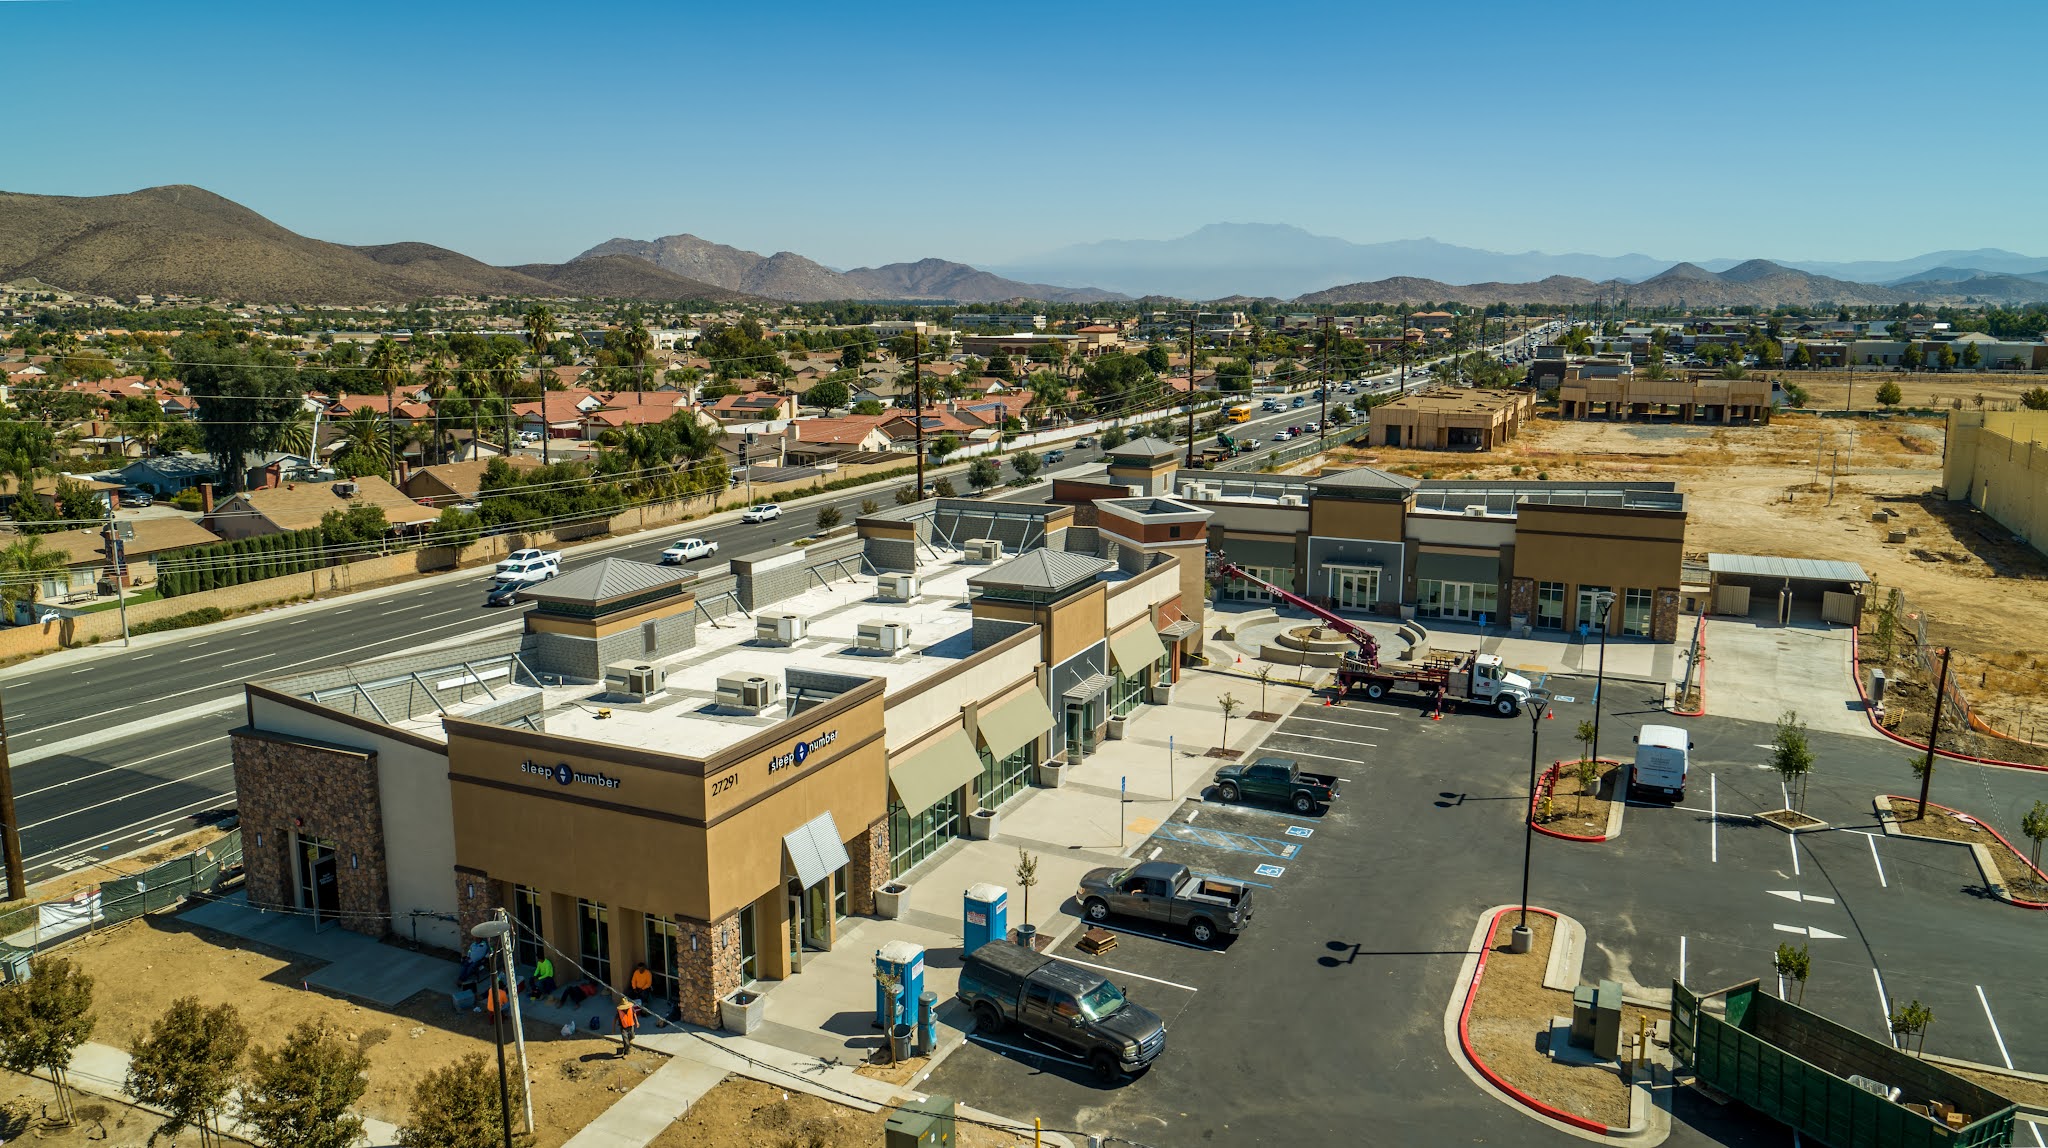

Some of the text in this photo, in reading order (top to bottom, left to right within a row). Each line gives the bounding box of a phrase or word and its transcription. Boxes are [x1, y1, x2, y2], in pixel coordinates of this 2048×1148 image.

[771, 730, 838, 772] sleep number
[521, 761, 619, 788] sleep number
[712, 773, 738, 797] 27291
